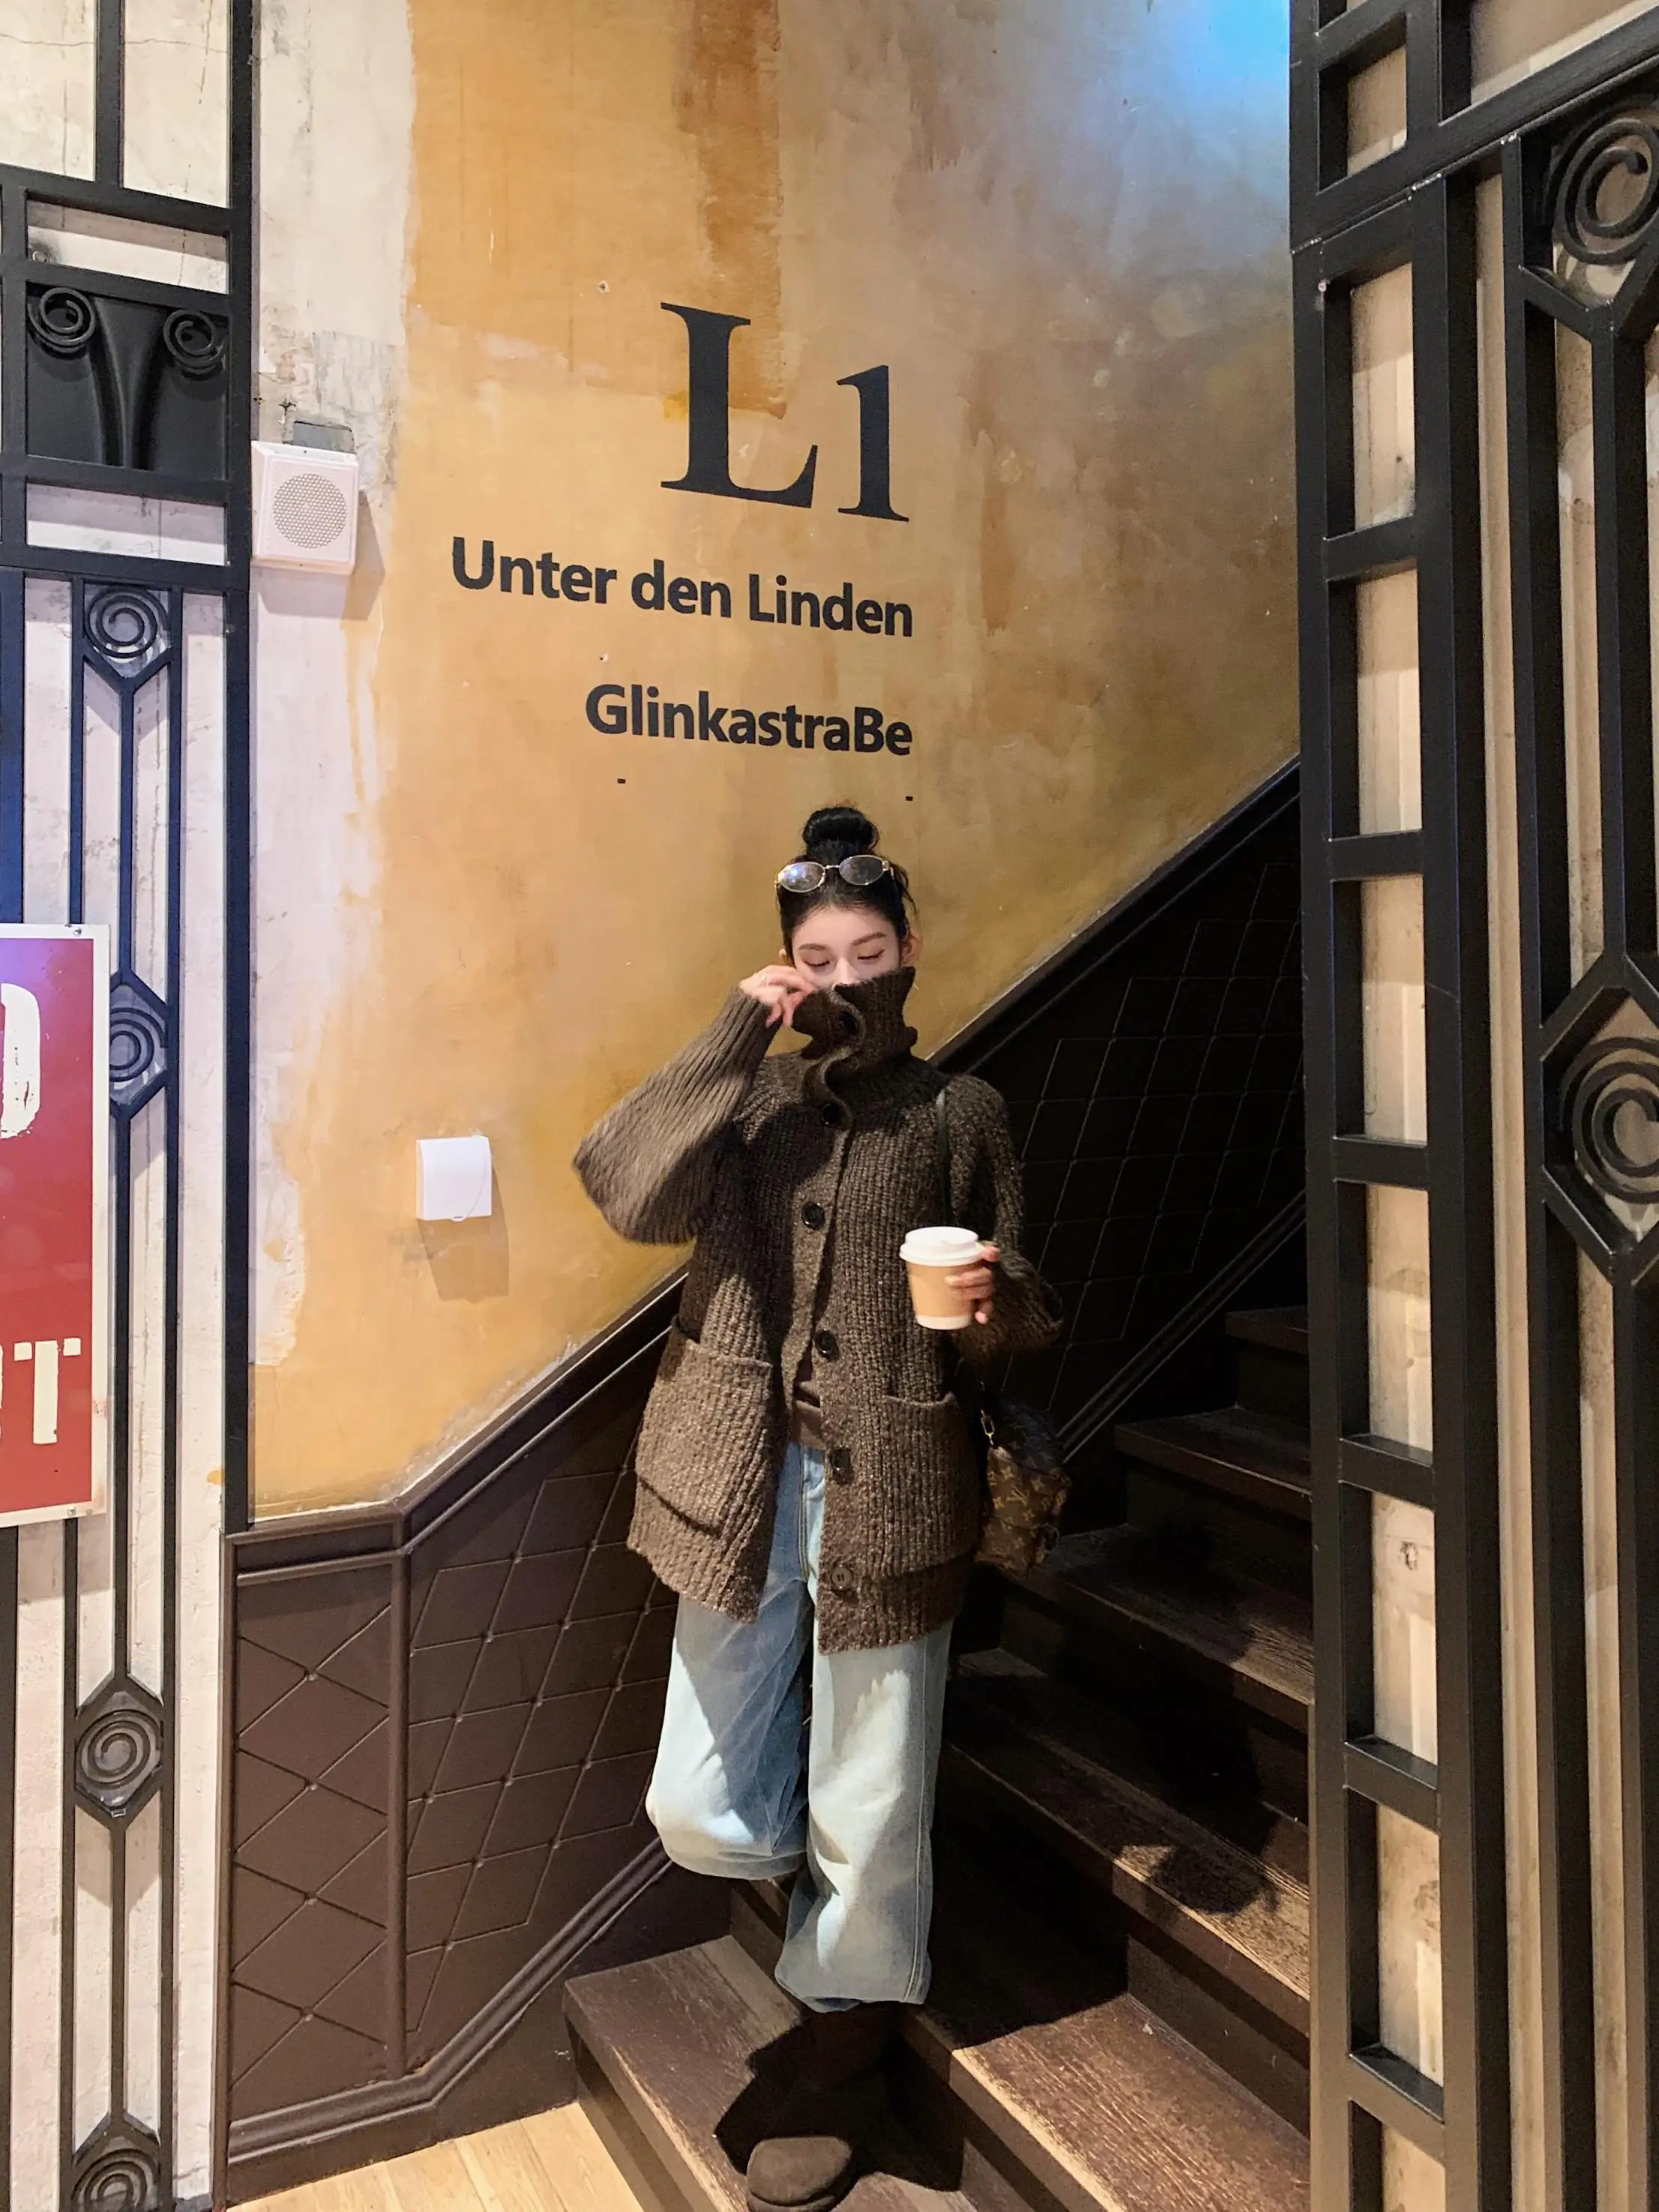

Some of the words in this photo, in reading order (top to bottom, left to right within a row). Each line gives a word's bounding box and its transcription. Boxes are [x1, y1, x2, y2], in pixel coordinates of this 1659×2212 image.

[660, 301, 910, 523] L1
[452, 536, 618, 604] Unter
[631, 559, 732, 619] den
[749, 573, 913, 638] Linden
[585, 684, 913, 757] GlinkastraBe
